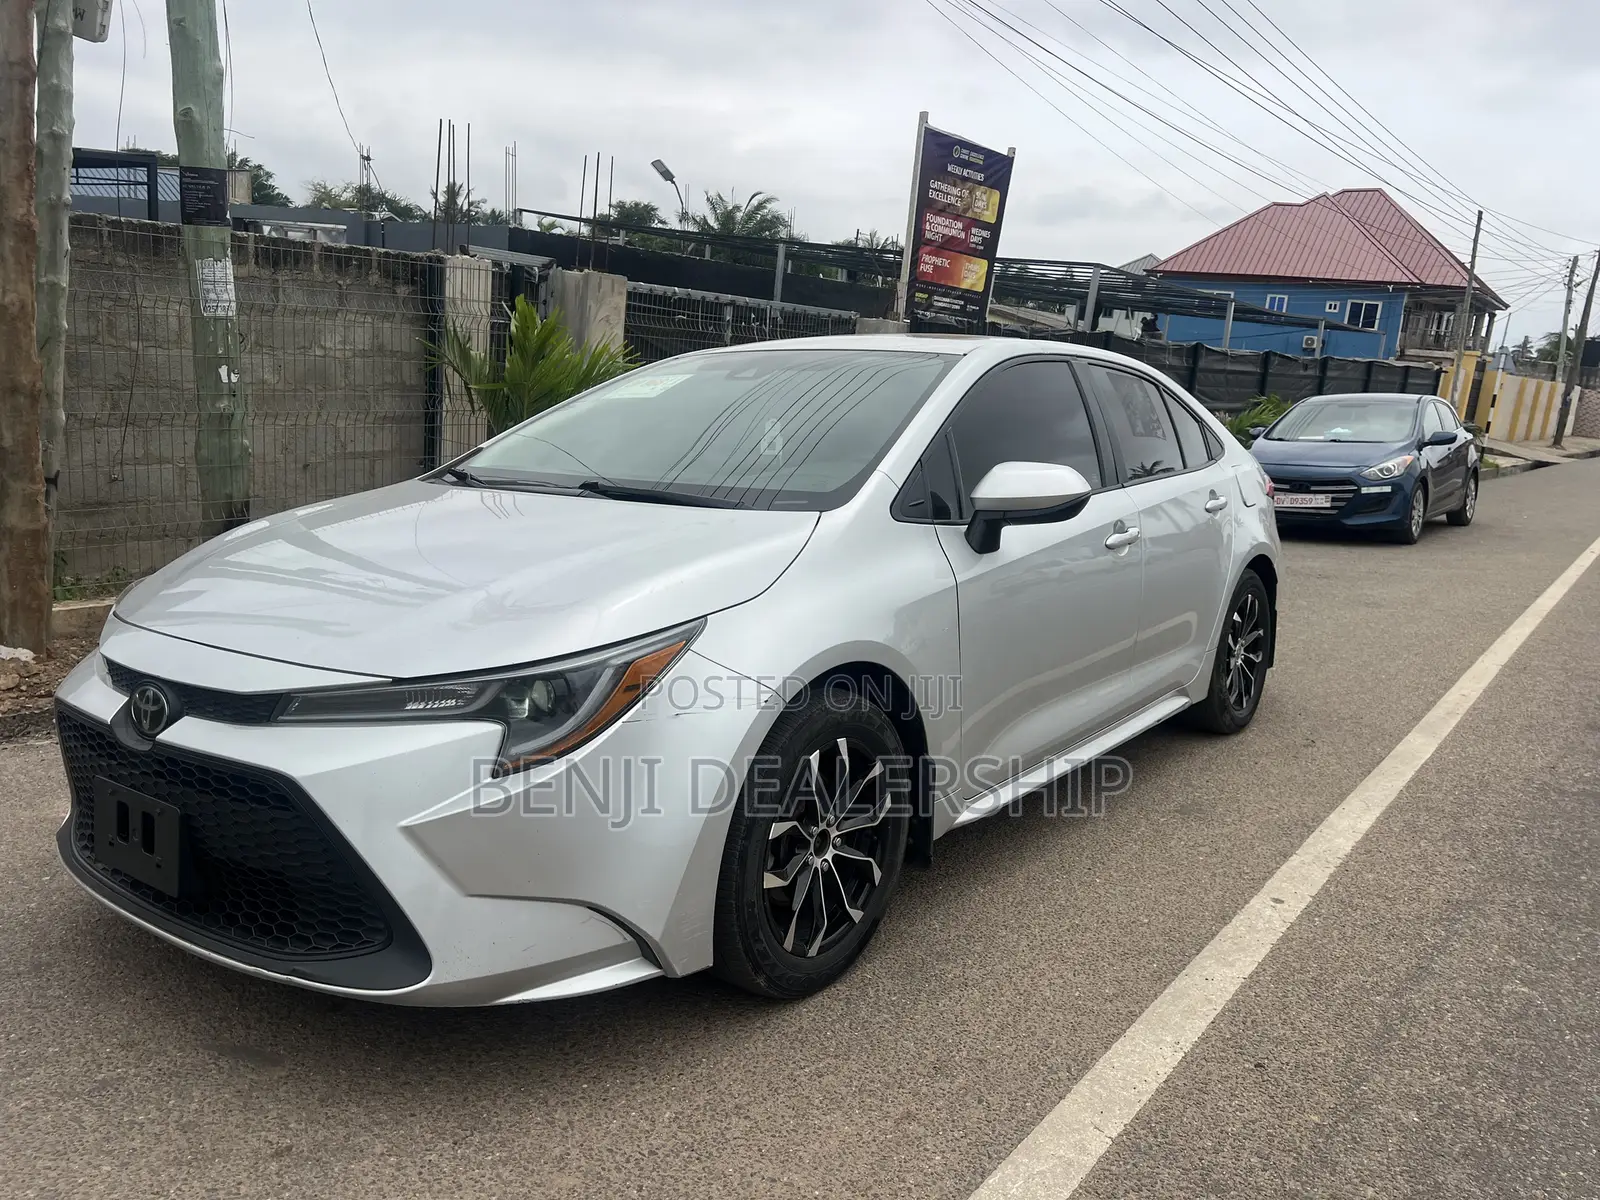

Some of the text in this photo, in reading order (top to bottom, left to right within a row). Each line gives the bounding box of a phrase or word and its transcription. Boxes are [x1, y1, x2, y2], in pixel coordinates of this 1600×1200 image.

[947, 163, 985, 182] WEEKLY ACTIVITIES
[929, 179, 970, 198] GATHERING OF
[928, 189, 961, 207] EXCELLENCE
[926, 213, 963, 230] FOUNDATION
[924, 230, 943, 242] NIGHT
[930, 223, 966, 239] COMMUNION
[971, 227, 991, 239] WEDNES
[970, 235, 983, 244] DAYS
[921, 253, 951, 268] PROPHETIC
[919, 263, 934, 274] FUSE
